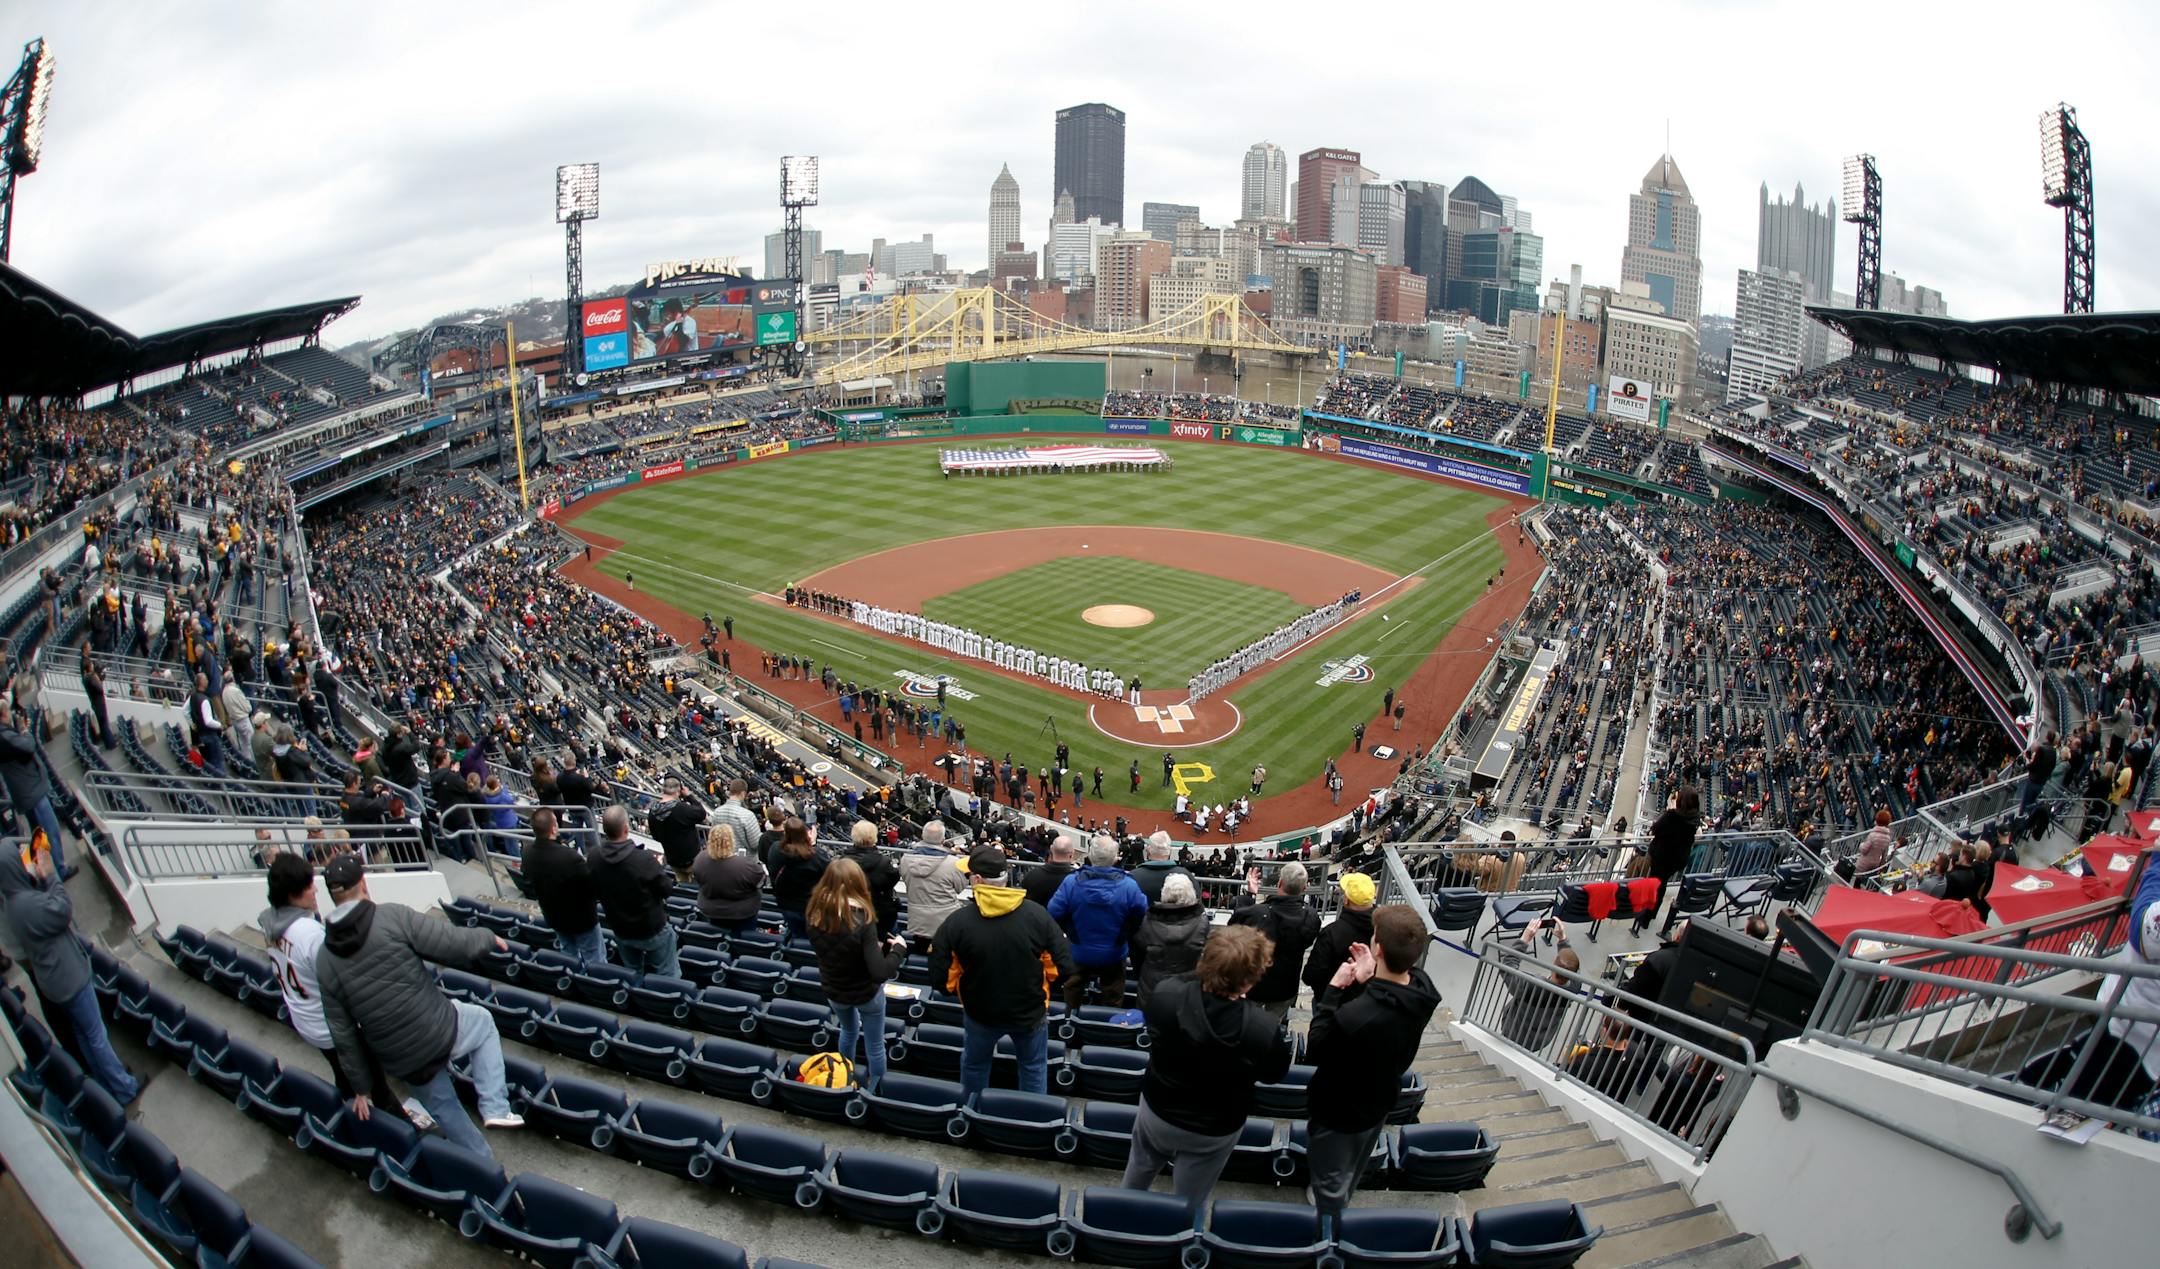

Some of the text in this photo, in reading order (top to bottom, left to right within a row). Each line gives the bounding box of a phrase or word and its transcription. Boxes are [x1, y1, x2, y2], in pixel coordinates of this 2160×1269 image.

[646, 256, 741, 288] PNC PARK
[771, 288, 792, 299] PNC
[587, 309, 622, 326] Coca-Cola
[1627, 384, 1635, 395] P
[1613, 397, 1644, 409] PIRATES
[1173, 423, 1210, 438] xfinity
[1221, 427, 1231, 440] P
[766, 442, 785, 454] MASON
[1442, 460, 1517, 482] NATIONAL ANTHEM PERFORMER
[1448, 468, 1480, 480] PITTSBURGH
[1480, 474, 1496, 484] CELLO
[1497, 479, 1522, 490] QUARTET
[1172, 762, 1216, 795] P
